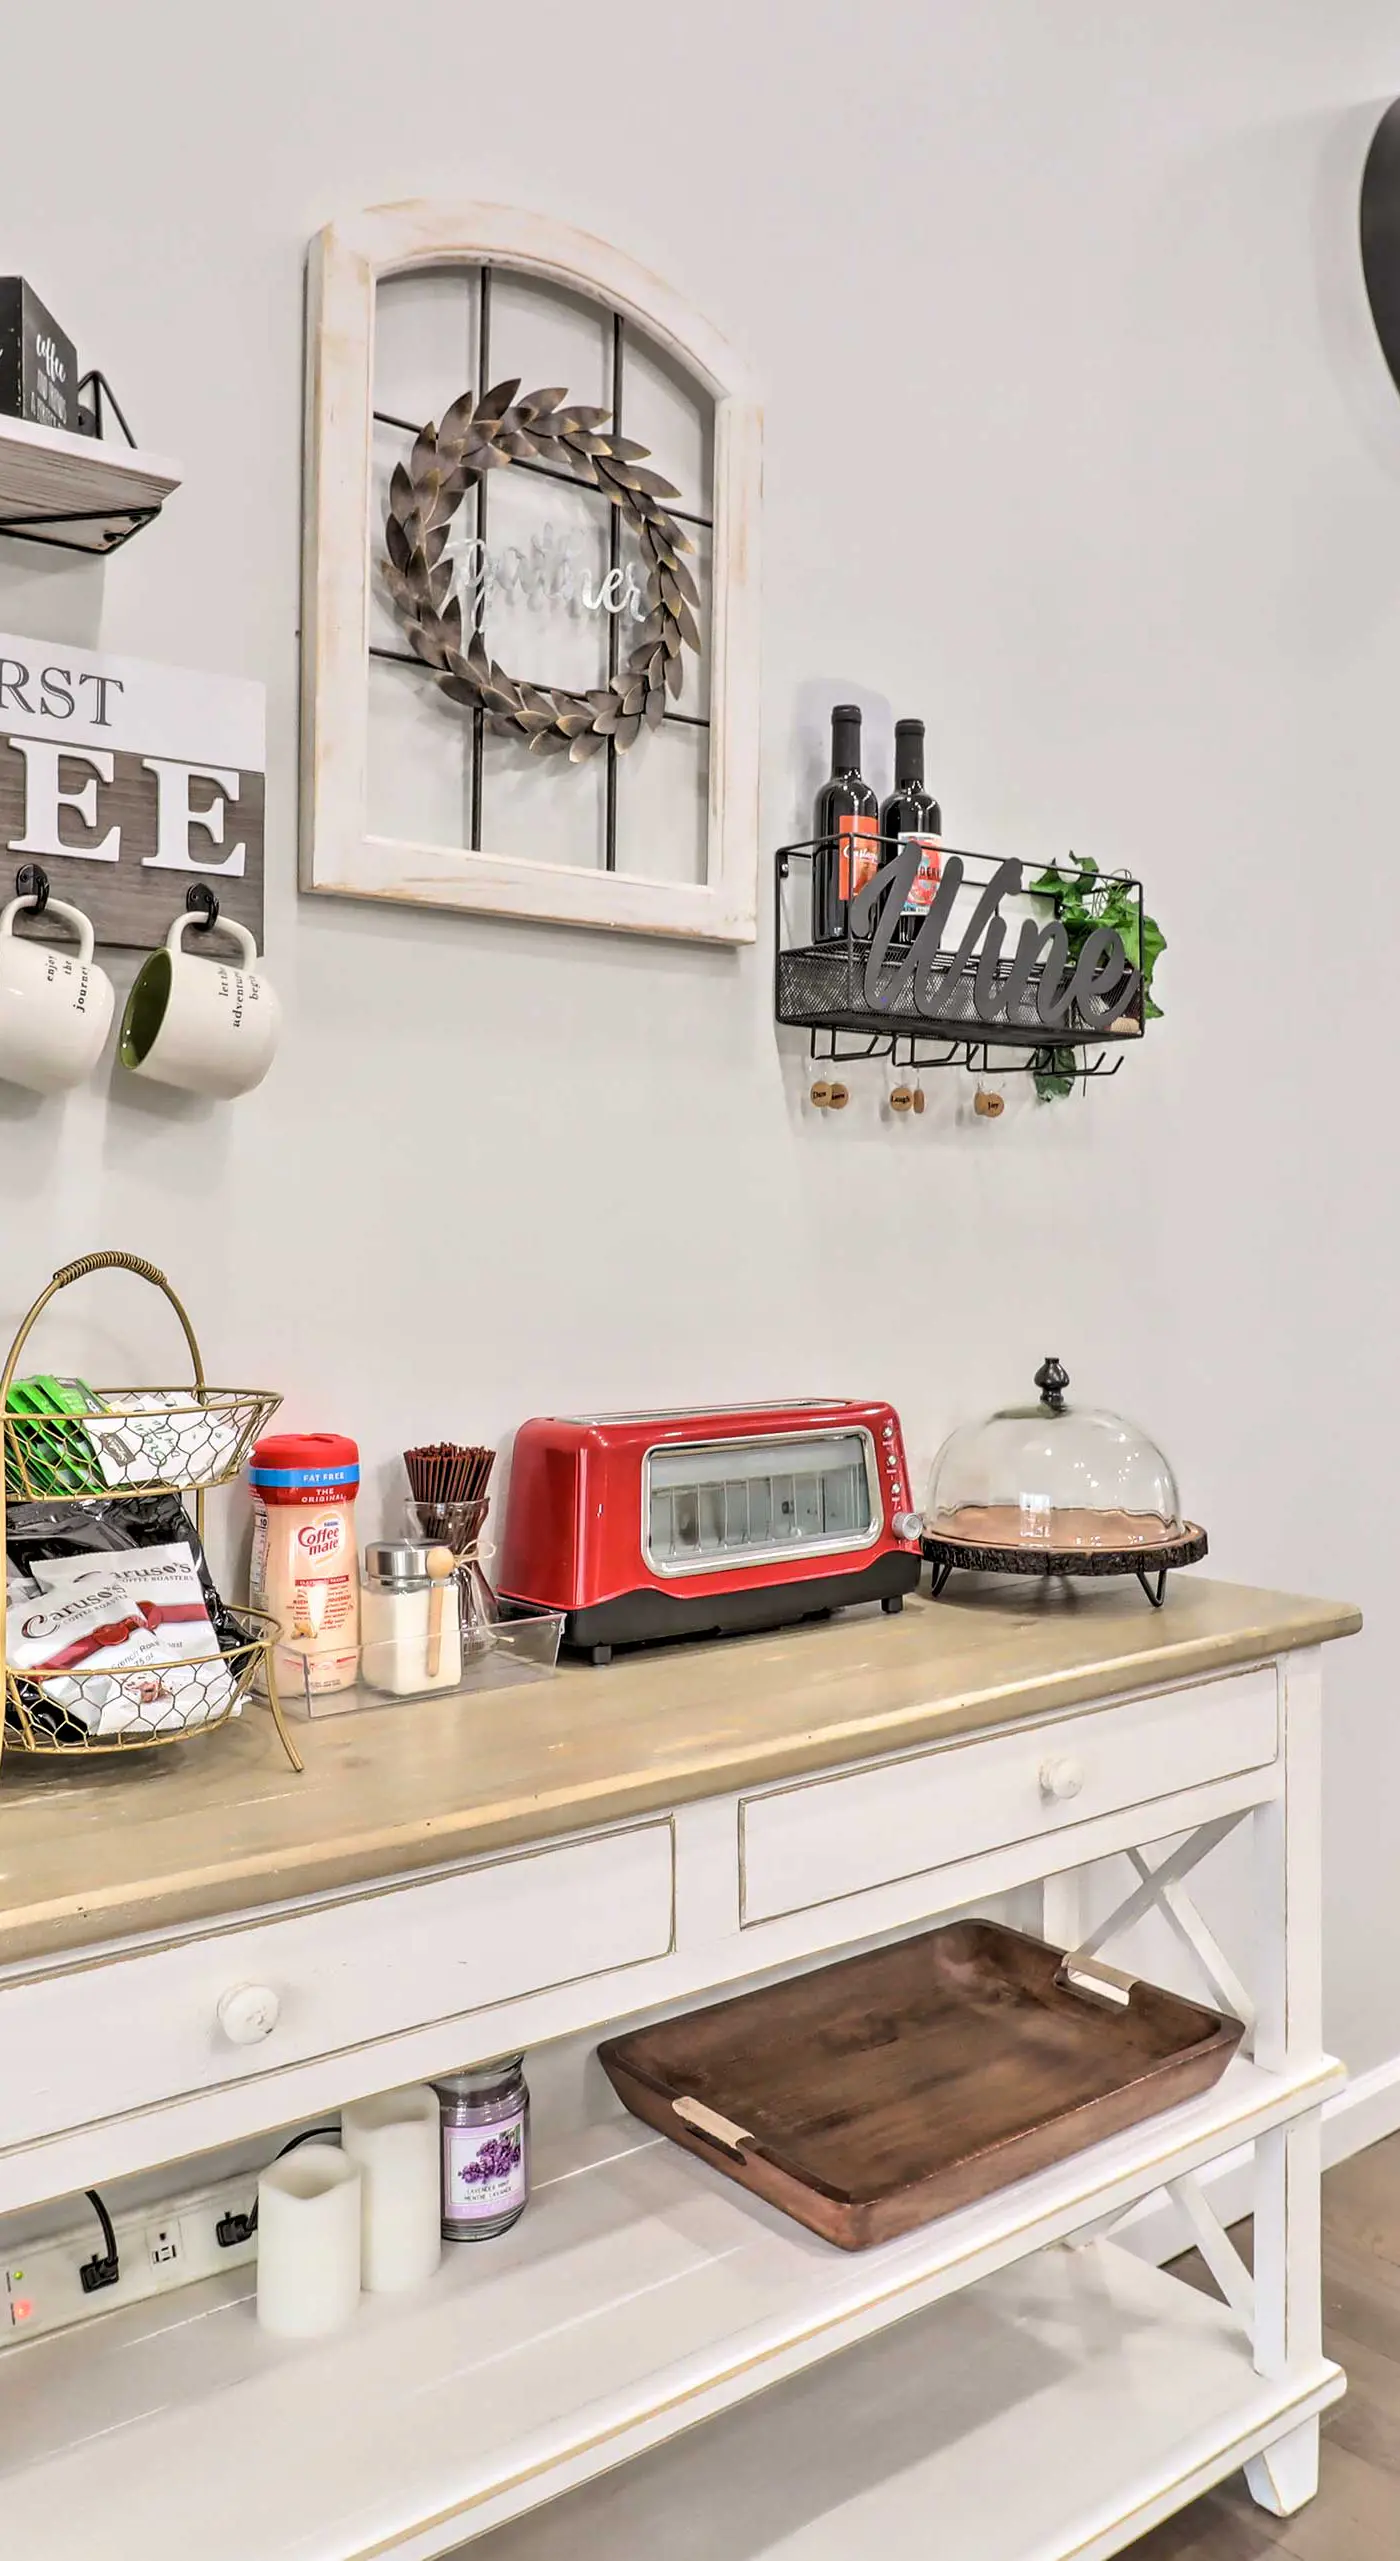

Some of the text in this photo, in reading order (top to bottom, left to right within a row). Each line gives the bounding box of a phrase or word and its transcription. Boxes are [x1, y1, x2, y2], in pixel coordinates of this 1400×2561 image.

[0, 658, 124, 727] RST
[850, 842, 1142, 1027] Wine
[303, 1471, 345, 1483] FAT FREE
[301, 1493, 345, 1503] ORIGINAL
[298, 1526, 340, 1547] Coffee
[309, 1538, 340, 1556] mate
[21, 1584, 127, 1639] Caruso's
